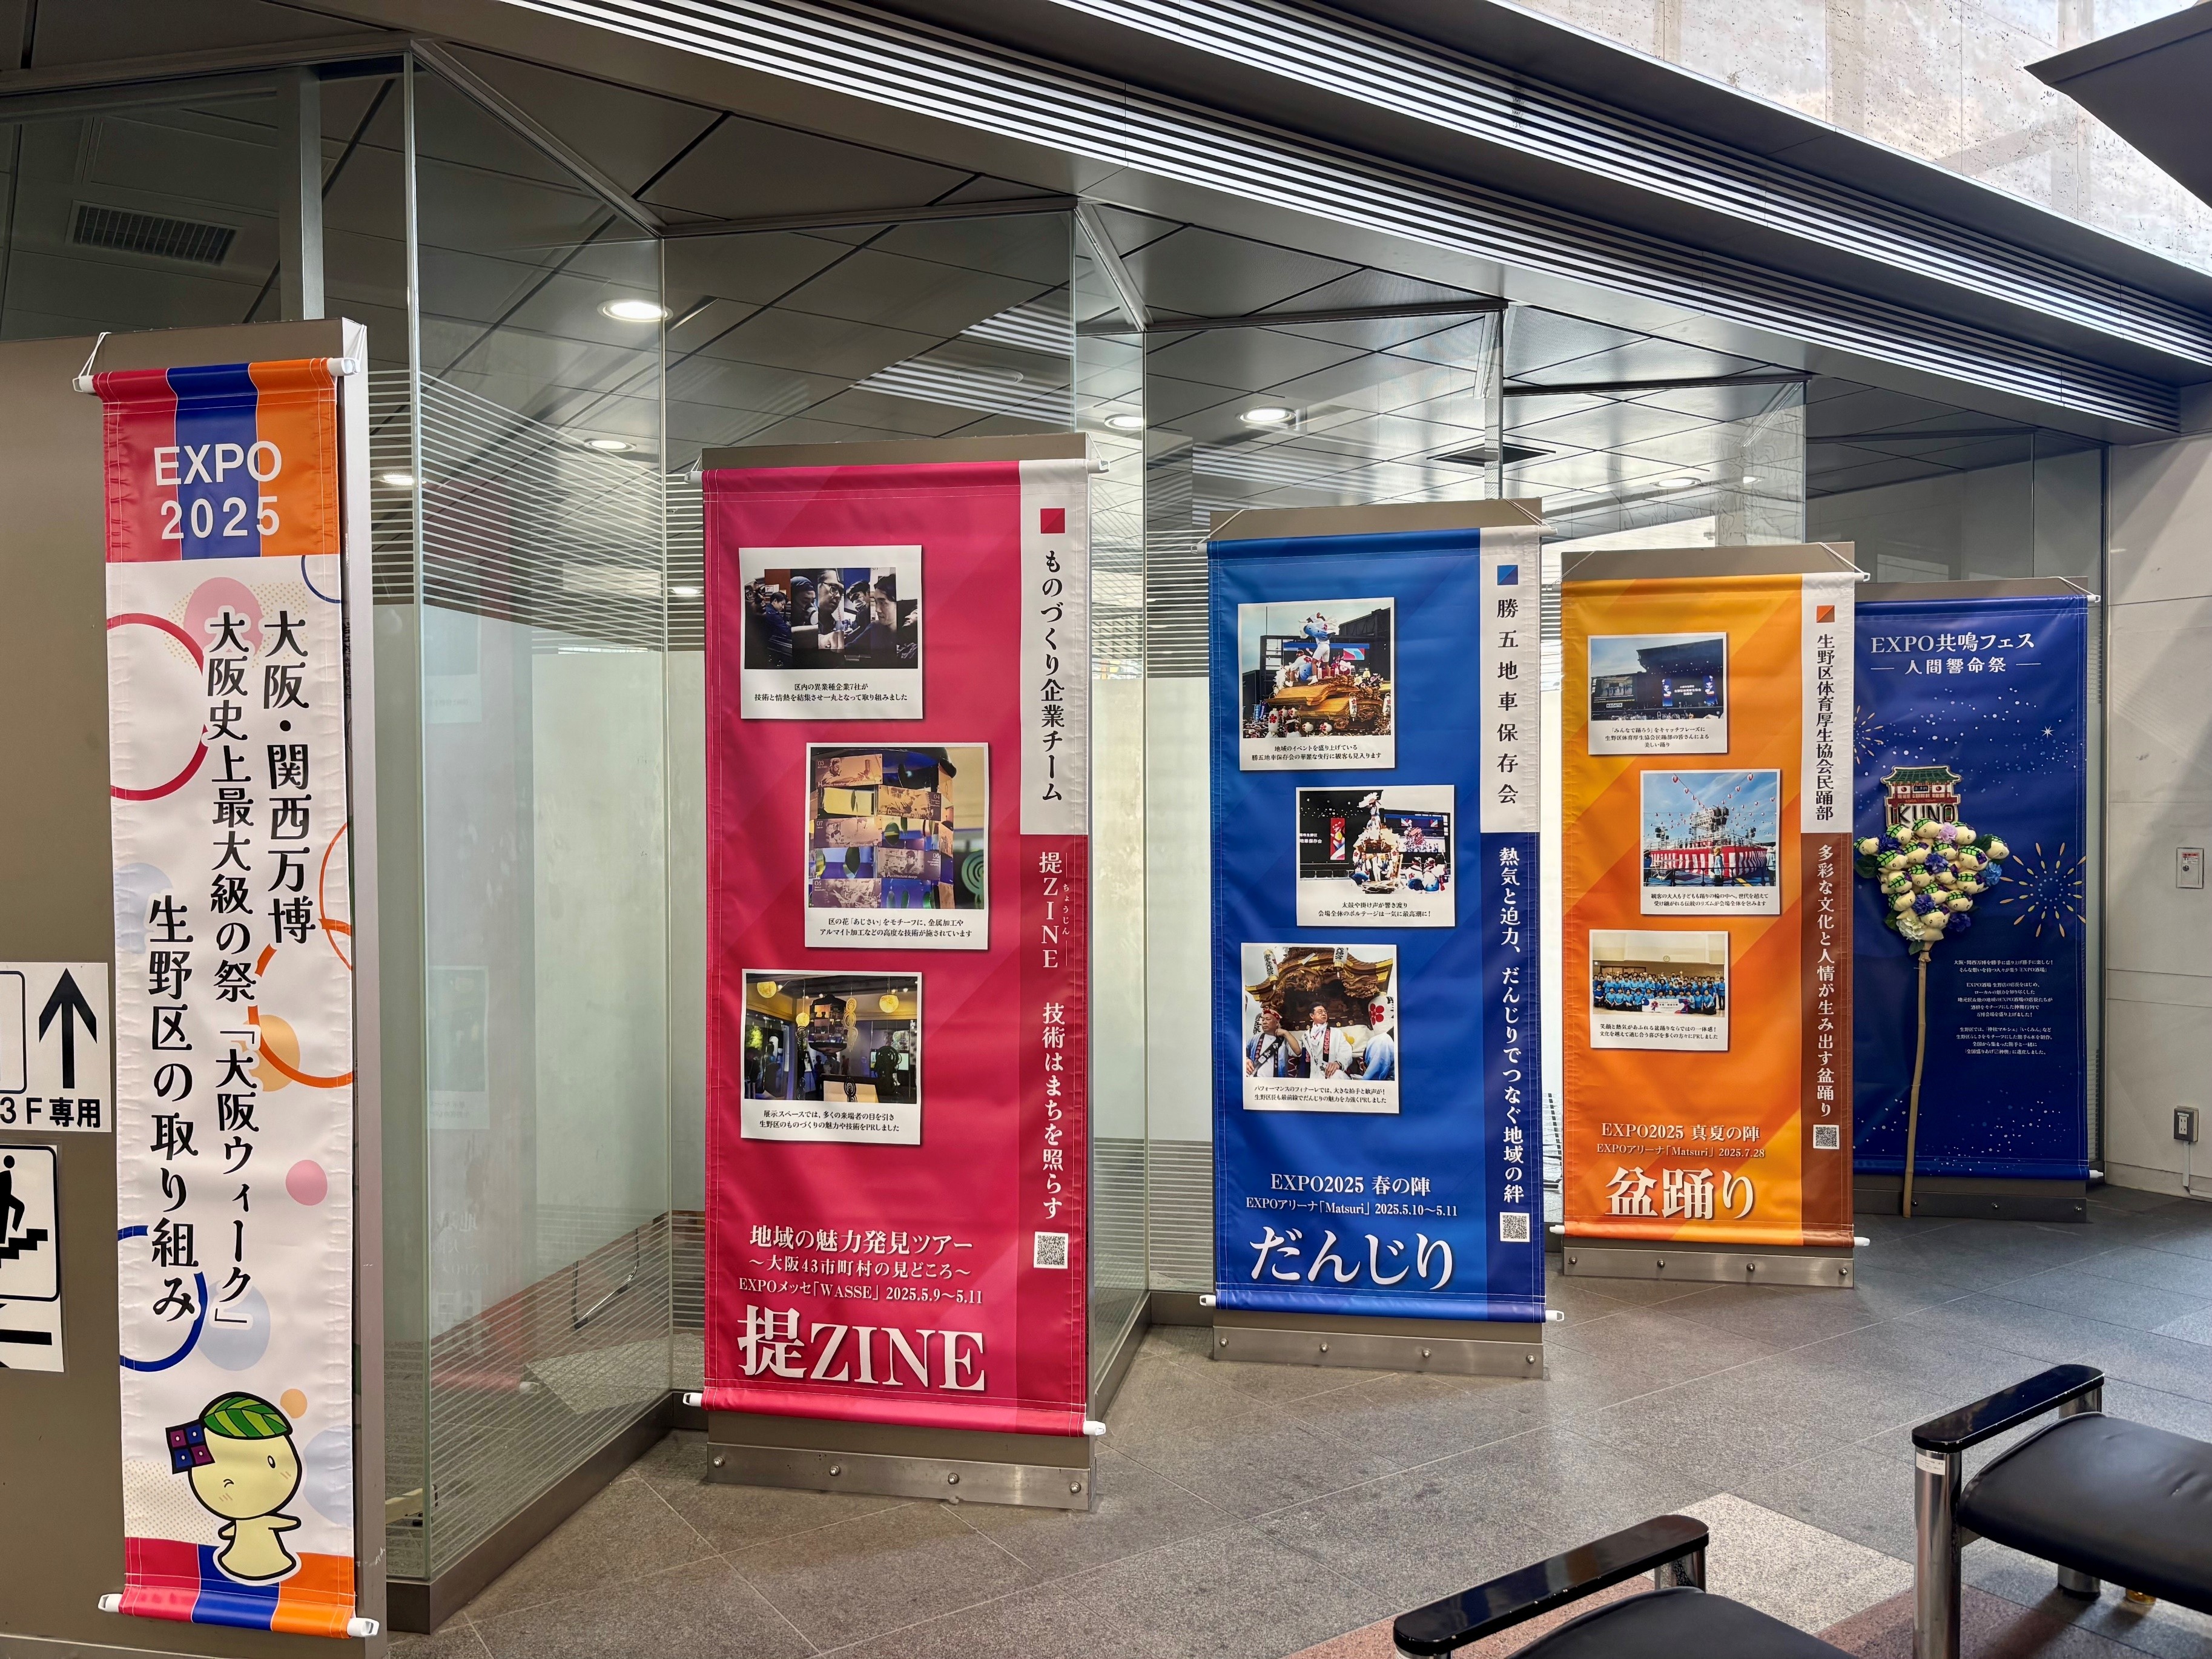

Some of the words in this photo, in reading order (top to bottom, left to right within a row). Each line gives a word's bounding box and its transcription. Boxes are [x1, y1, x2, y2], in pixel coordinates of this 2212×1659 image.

[154, 441, 283, 486] EXPO
[160, 496, 280, 539] 2025
[1870, 632, 2035, 654] EXPO共鳴フェス
[1904, 656, 2006, 675] 人間響命祭
[754, 693, 908, 702] 技術と情熱を結集させ一丸となって取り組みました
[1040, 550, 1065, 801] ものづくり企業チーム
[1496, 598, 1519, 804] 勝五地車保存会
[1815, 633, 1835, 821] 生野区体育厚生協会民踊部
[262, 610, 316, 945] 大阪・関西万博
[1890, 804, 1955, 824] IKUNO
[819, 928, 972, 938] アルマイト加工などの高度な技術が施されています
[1038, 851, 1063, 968] 提ZINE
[1062, 883, 1071, 936] ちょうじん
[206, 611, 260, 1325] 大阪史上最大級の祭「大阪ウィーク」
[1816, 844, 1835, 1118] 多彩な文化と人情が生み出す盆踊り
[1499, 847, 1524, 1204] 熱気と迫力、だんじりでつなぐ地域の絆
[148, 894, 199, 1322] 生野区の取り組み
[759, 1121, 899, 1132] 生野区のものづくりの魅力や技術をPRしました
[764, 1110, 895, 1121] 展示スペースでは、多くの来場者の目を引き
[1042, 1001, 1065, 1220] 技術はまちを照らす
[1601, 1123, 1684, 1140] EXPO2025
[1690, 1124, 1760, 1143] 真夏の陣
[1718, 1147, 1765, 1158] 2025.7.28
[1270, 1173, 1364, 1193] EXPO2025
[1371, 1175, 1431, 1197] 春の陣
[1605, 1166, 1754, 1219] 盆踊り
[750, 1224, 972, 1255] 地域の魅力発見ツアー
[1249, 1226, 1453, 1290] だんじり
[737, 1304, 986, 1391] 提ZINE
